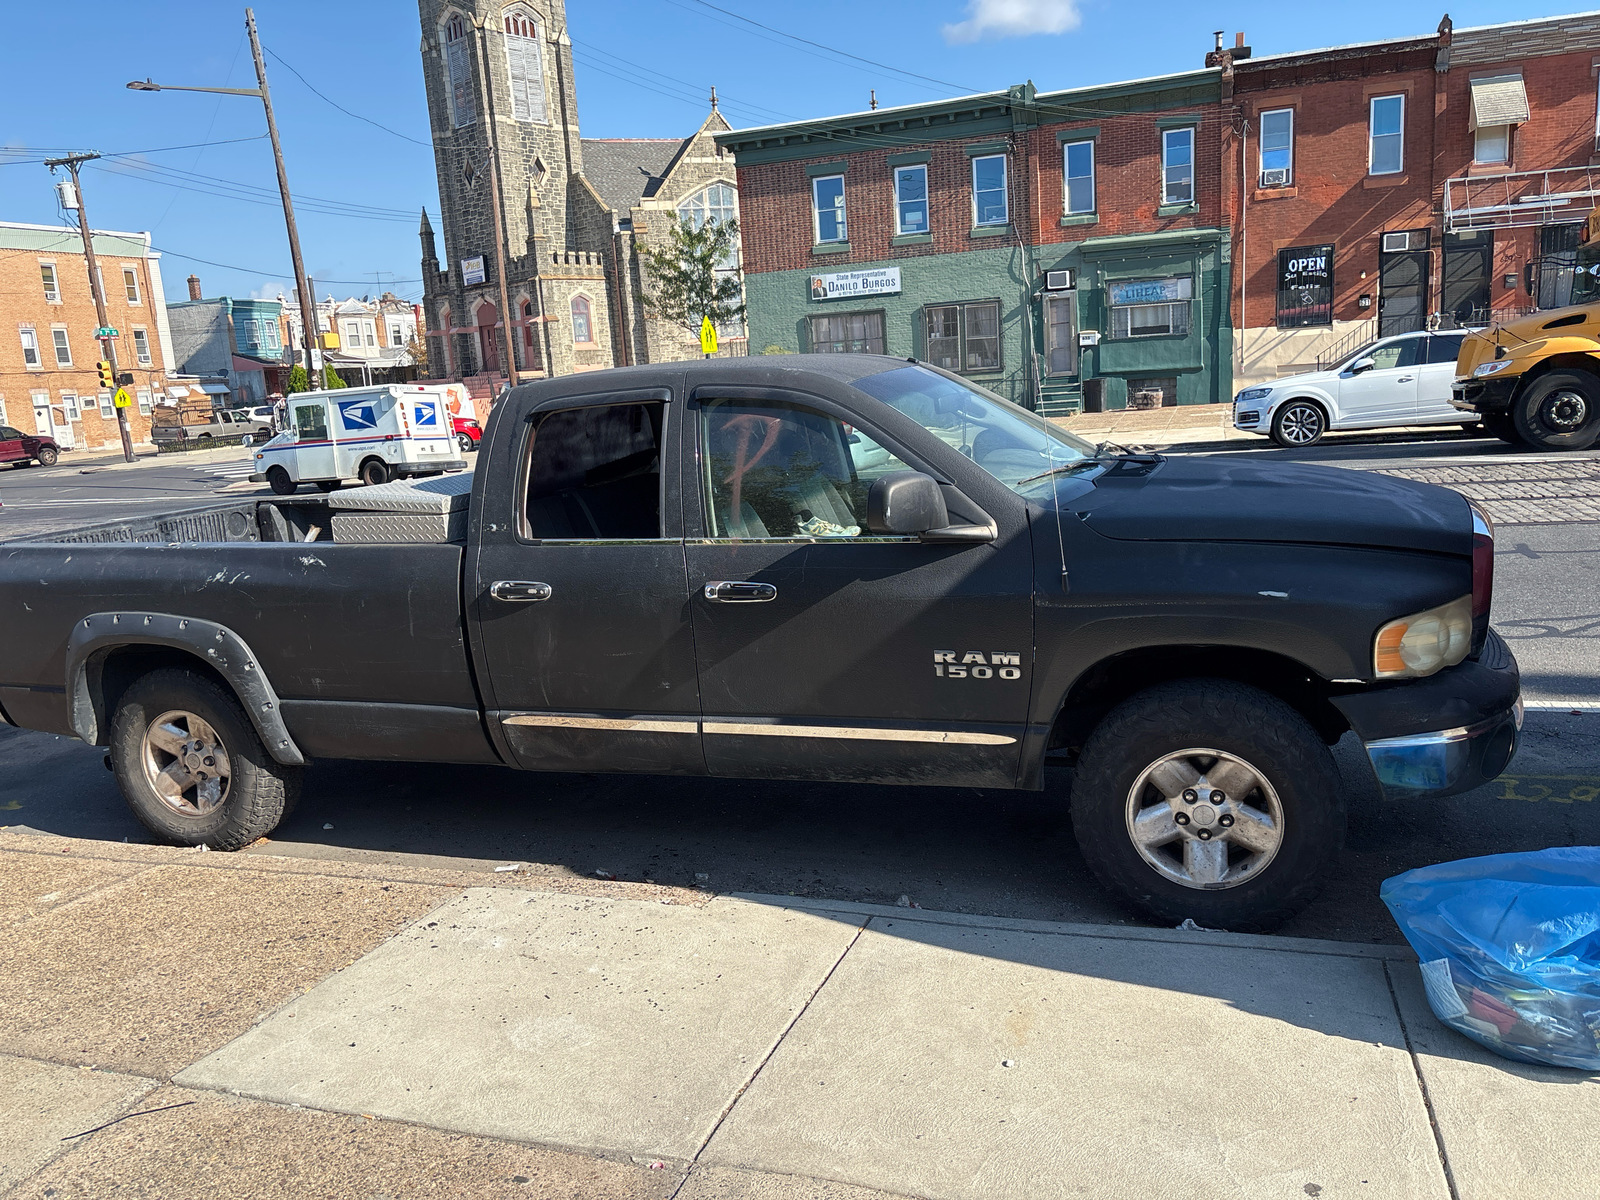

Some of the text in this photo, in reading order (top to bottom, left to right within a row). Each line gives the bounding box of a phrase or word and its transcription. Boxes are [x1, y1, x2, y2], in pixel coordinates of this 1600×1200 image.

[1289, 256, 1326, 272] OPEN
[850, 270, 886, 280] Representative
[1285, 272, 1297, 282] Su
[828, 278, 896, 293] DANILO BURGOS
[1125, 285, 1166, 299] LIHEAP
[933, 649, 1021, 666] RAM
[933, 663, 1021, 680] 1500
